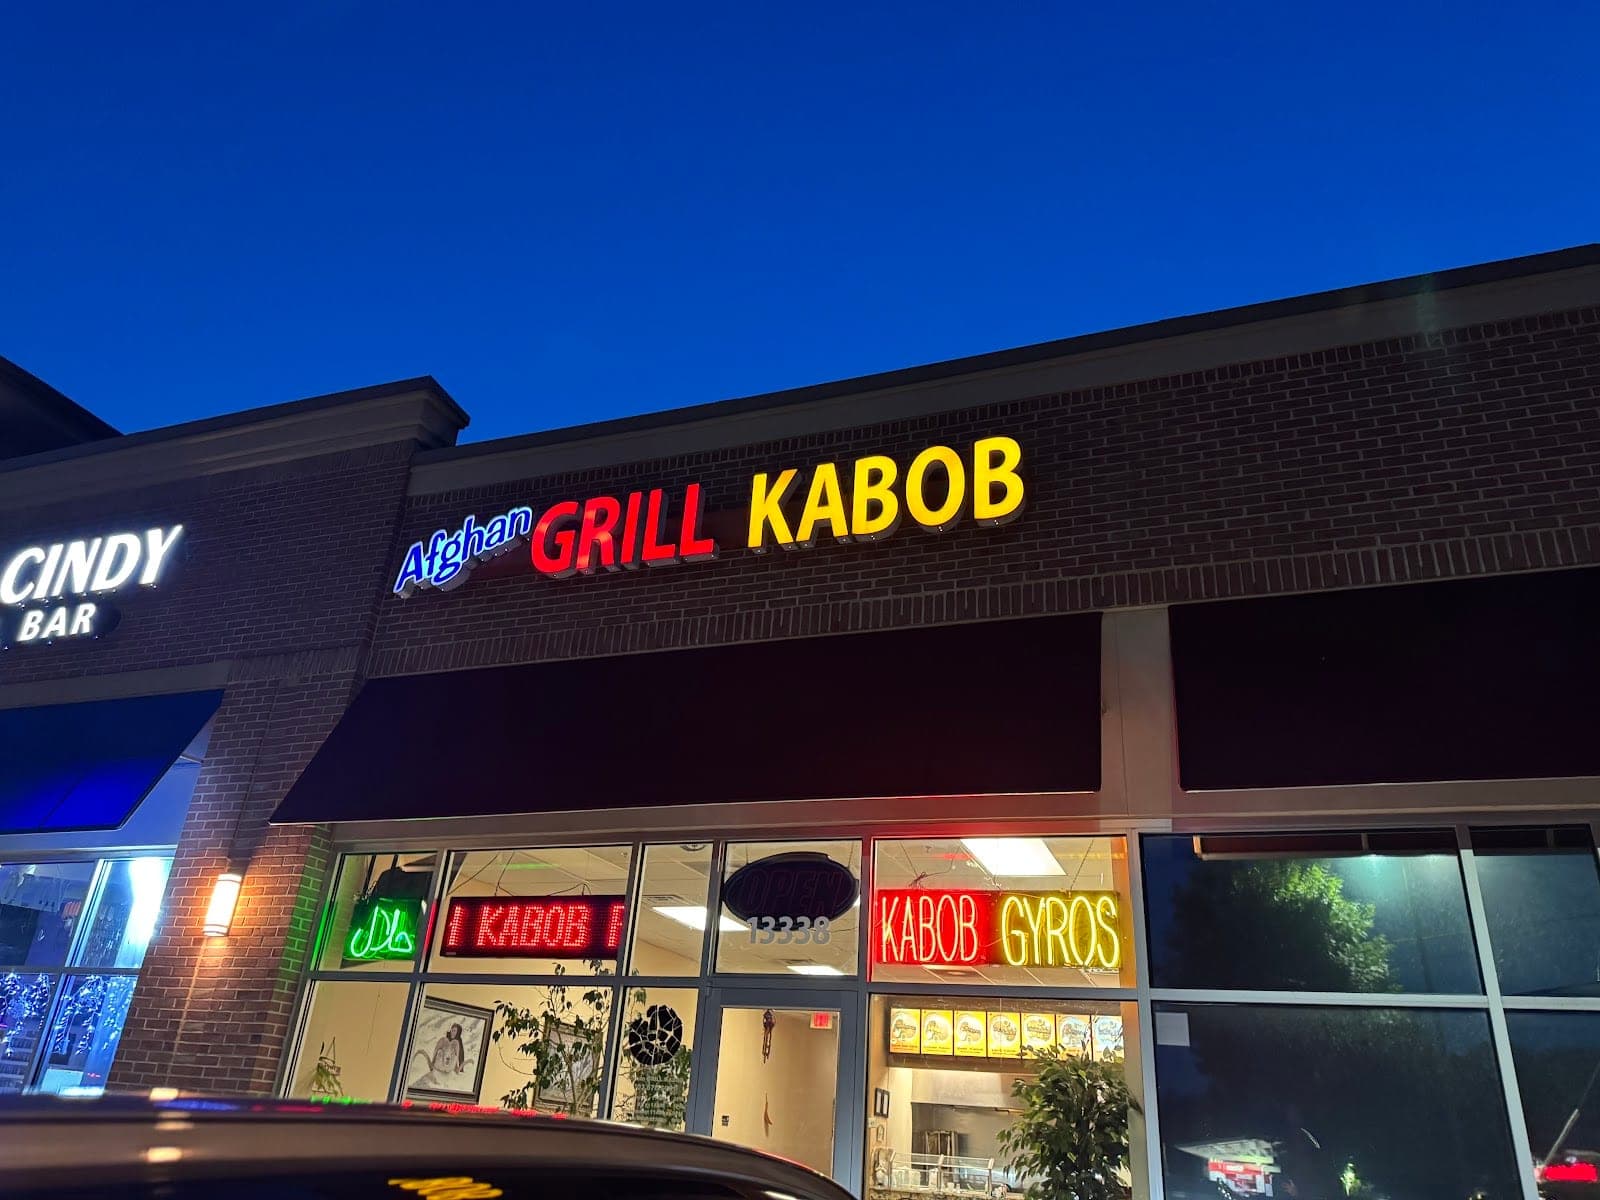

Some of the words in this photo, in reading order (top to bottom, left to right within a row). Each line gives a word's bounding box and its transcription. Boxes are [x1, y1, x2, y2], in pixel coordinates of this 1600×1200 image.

[393, 506, 533, 593] Afghan
[531, 483, 715, 574] GRILL
[747, 436, 1024, 548] KABOB
[0, 524, 183, 604] CINDY
[16, 602, 97, 642] BAR
[476, 904, 590, 947] KABOB
[747, 915, 831, 945] 13338
[881, 894, 979, 963] KABOB
[1001, 895, 1121, 967] GYROS
